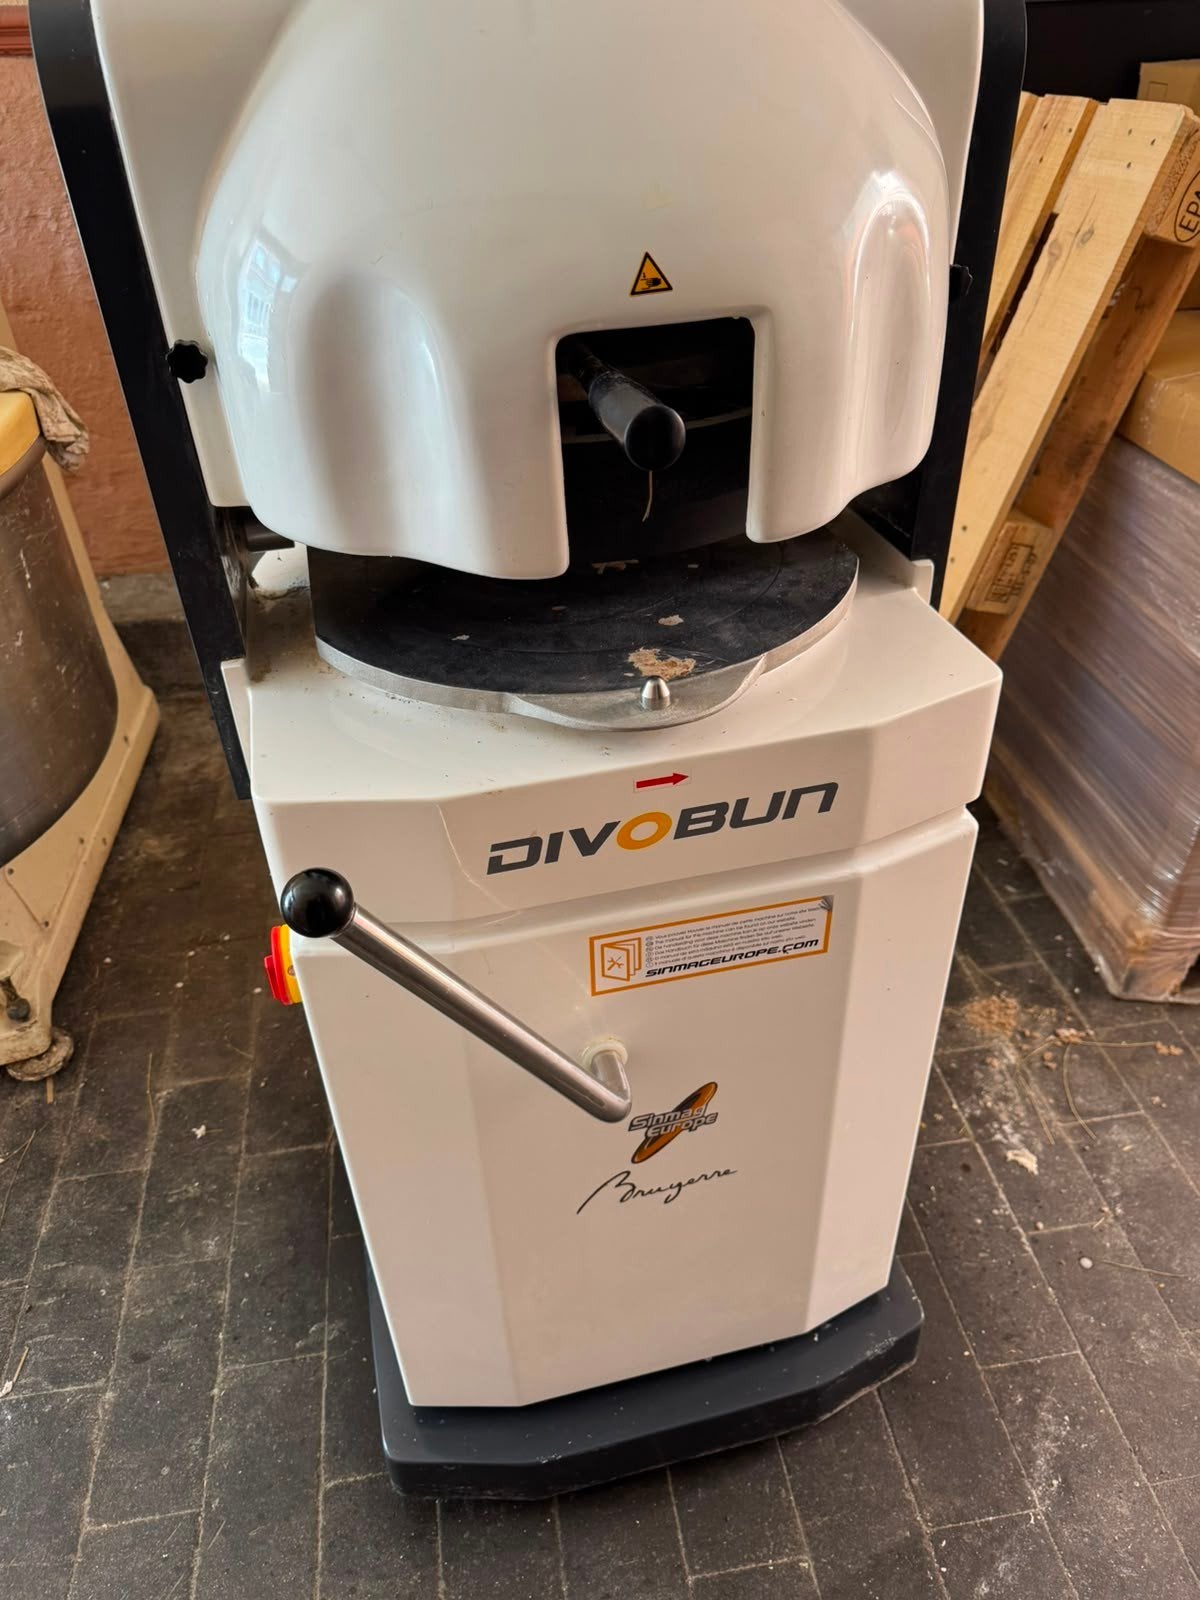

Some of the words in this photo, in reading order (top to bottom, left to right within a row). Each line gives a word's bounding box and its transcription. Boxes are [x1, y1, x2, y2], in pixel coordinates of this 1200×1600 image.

[487, 781, 839, 875] DIVOBUN
[645, 938, 819, 977] SINMAGEUROPE.COM
[628, 1106, 706, 1131] Sinmag
[645, 1112, 719, 1138] Europe
